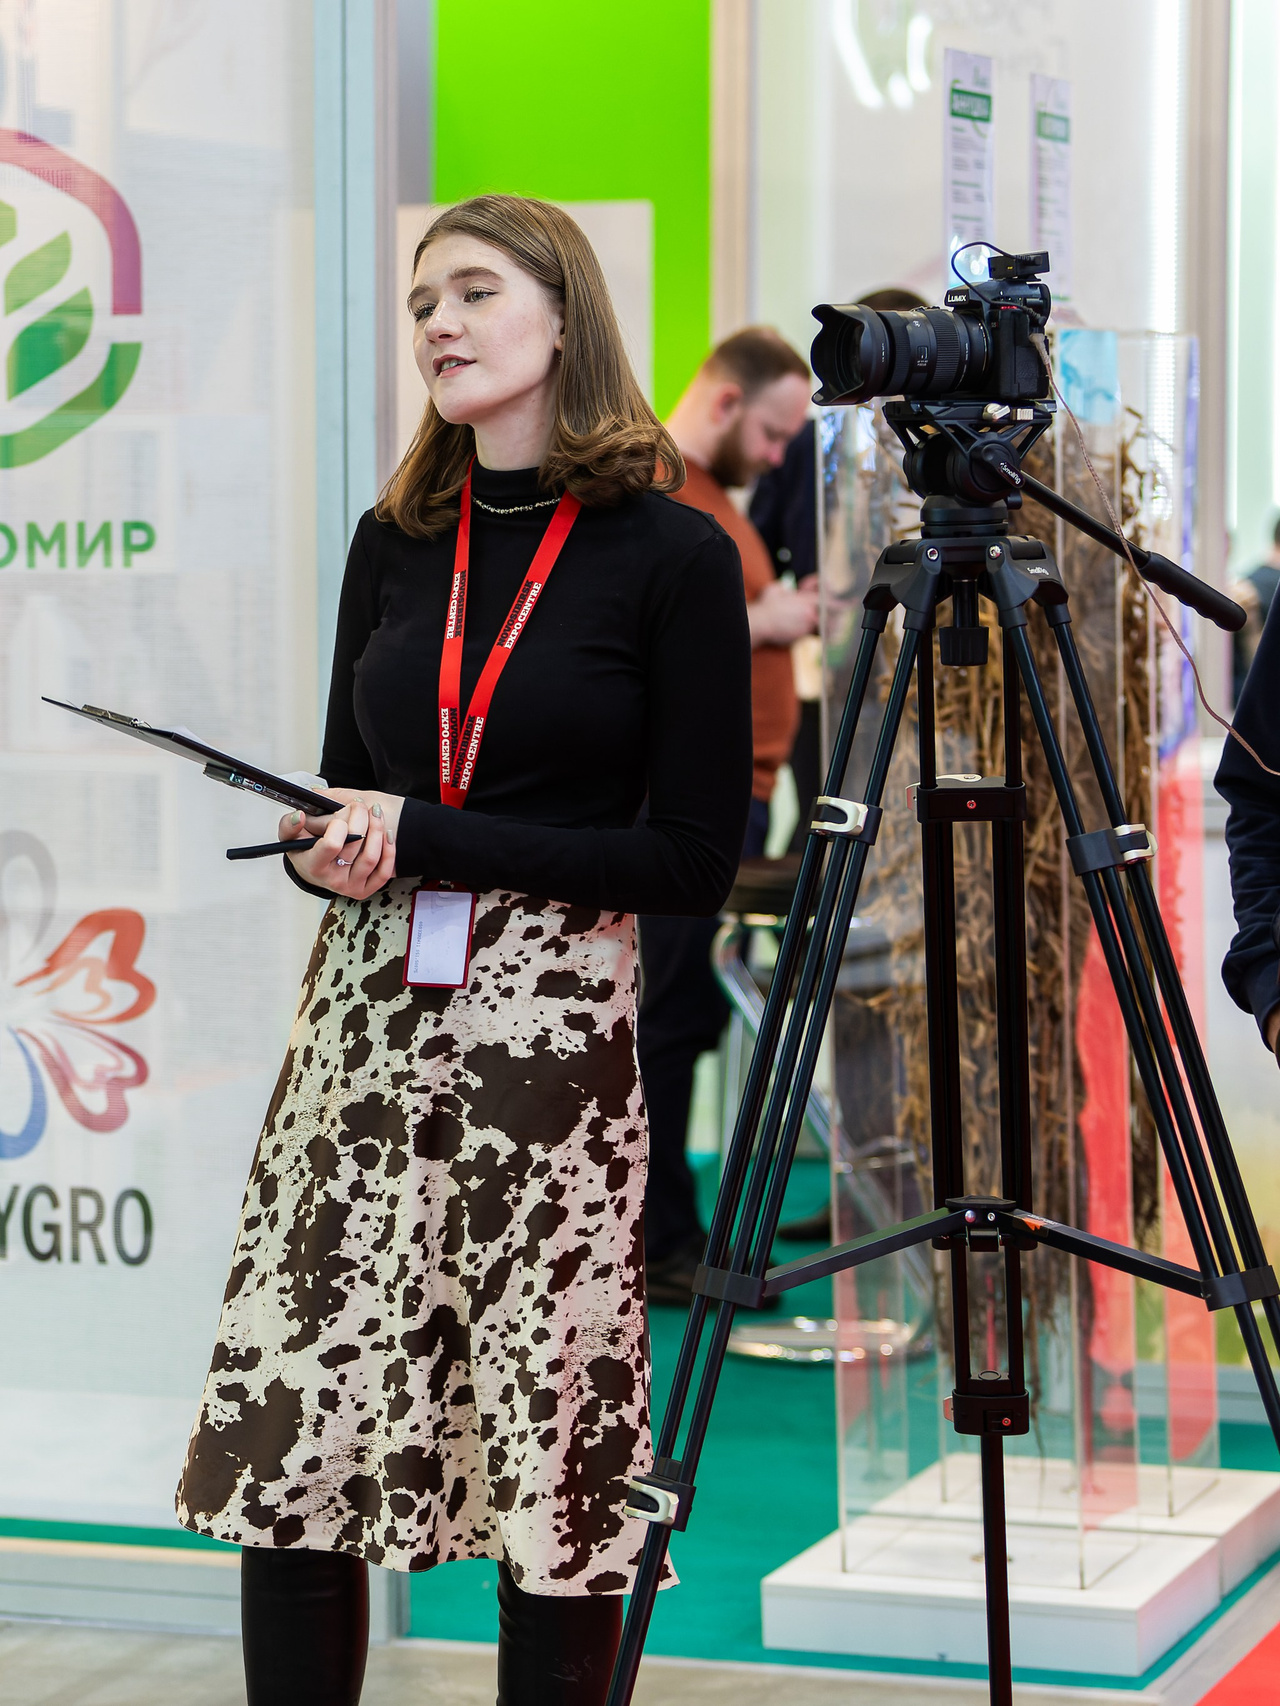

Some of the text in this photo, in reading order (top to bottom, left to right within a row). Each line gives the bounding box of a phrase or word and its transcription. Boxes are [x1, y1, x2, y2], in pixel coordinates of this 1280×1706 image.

[947, 294, 967, 303] LUMIX
[446, 599, 458, 639] CENTRE
[496, 580, 534, 647] NOVOSIBIRSK
[503, 582, 542, 650] EXPO CENTRE
[440, 707, 451, 784] EXPO CENTRE
[450, 714, 476, 789] NOVOSIBIRSK
[459, 716, 485, 790] EXPO CENTRE
